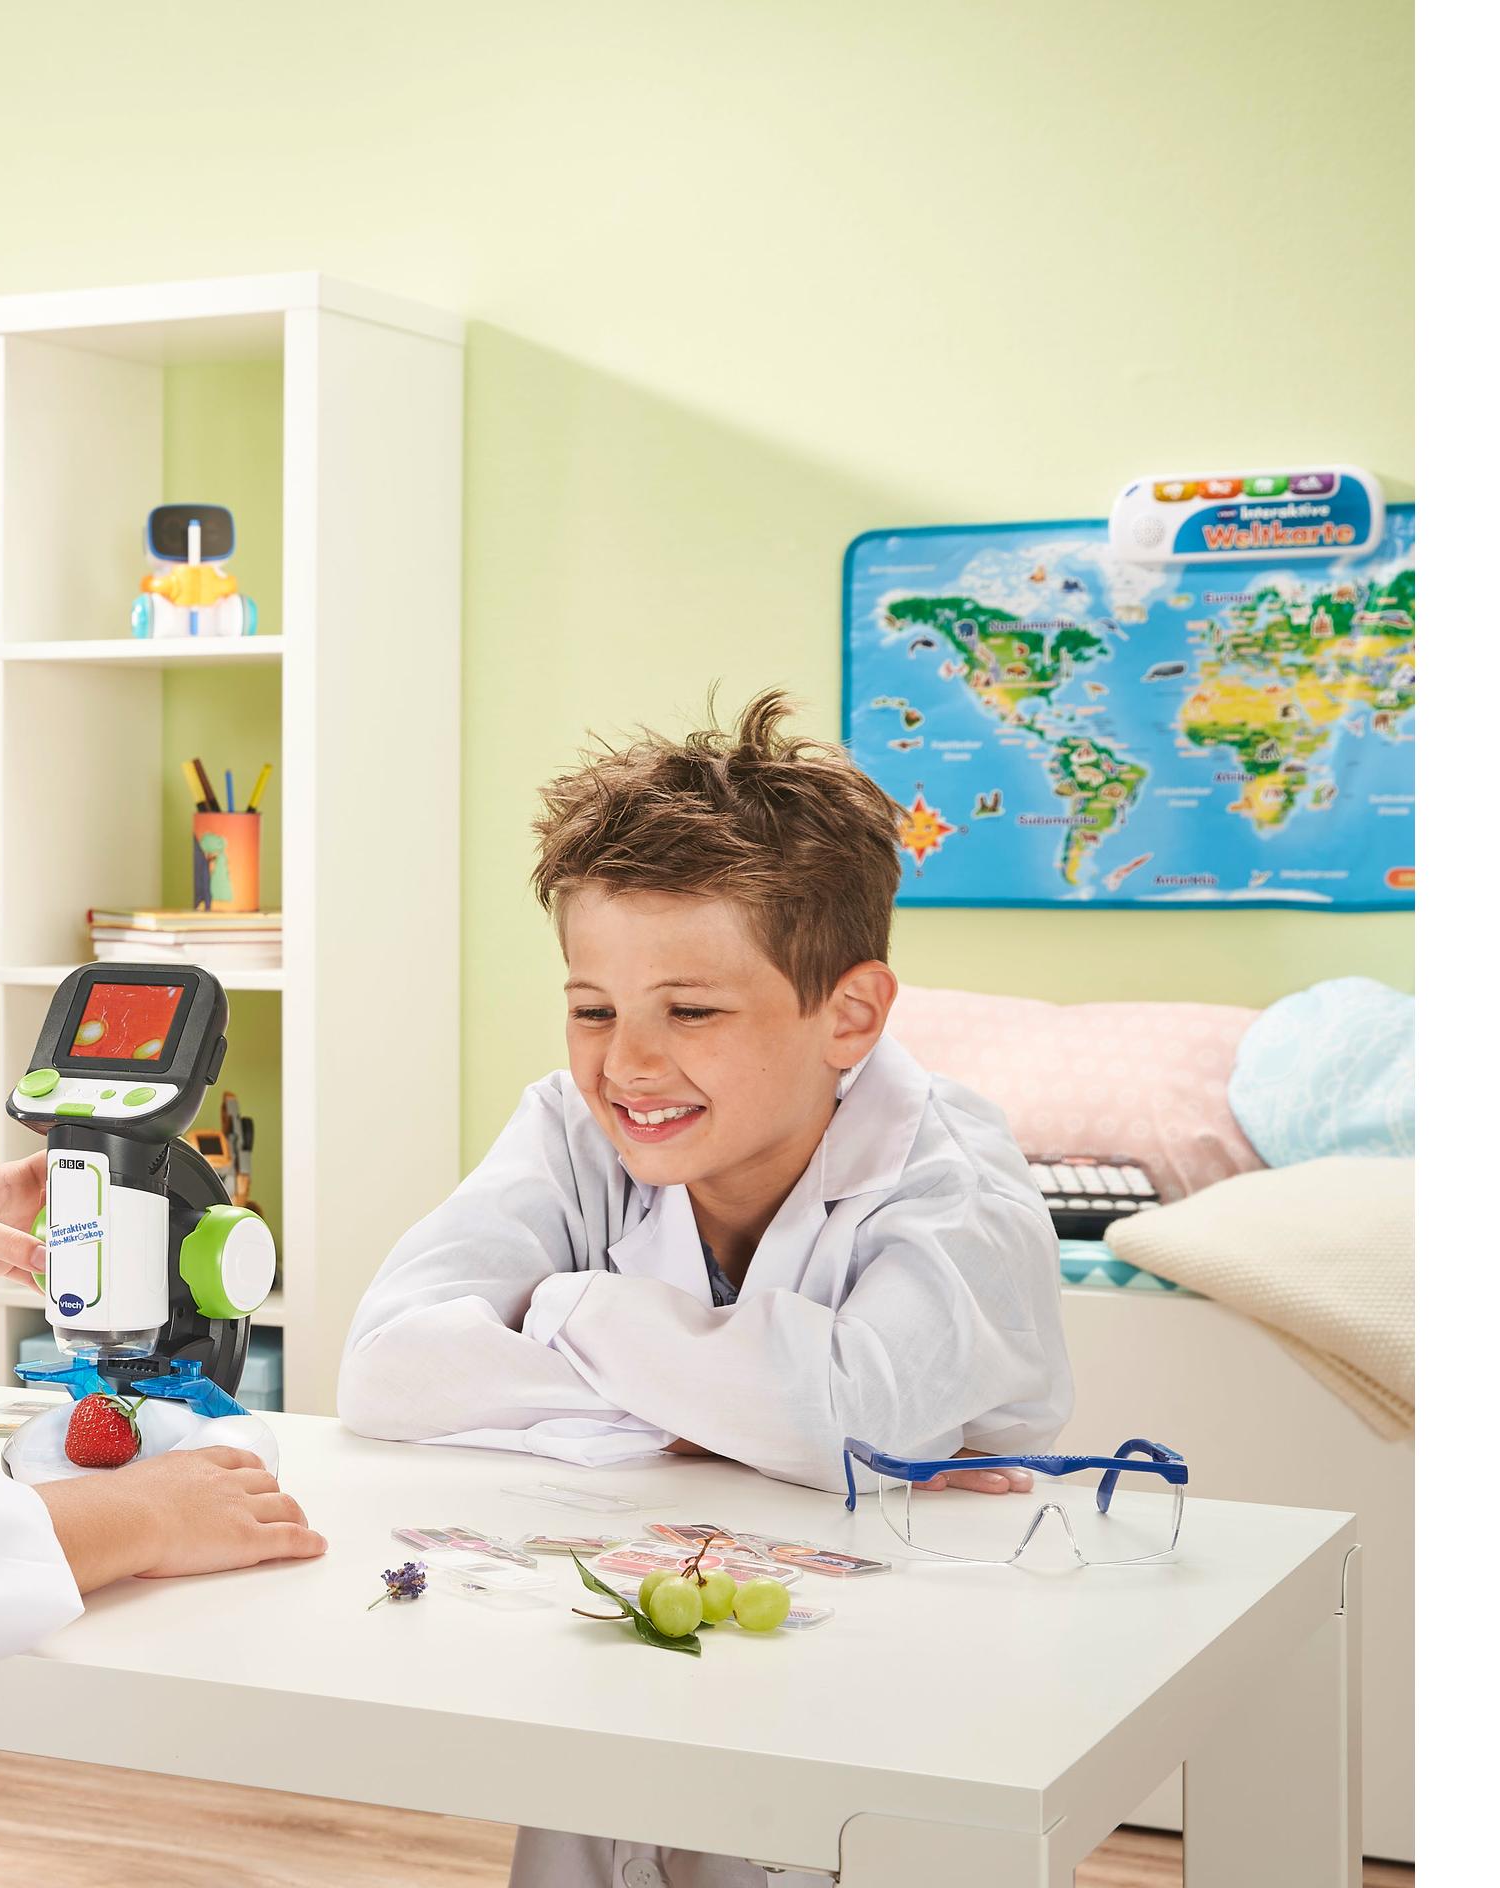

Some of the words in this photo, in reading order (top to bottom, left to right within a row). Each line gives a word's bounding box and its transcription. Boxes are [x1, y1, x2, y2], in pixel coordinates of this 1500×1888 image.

[1240, 503, 1330, 521] Interaktive
[1203, 521, 1355, 549] Weltkarte
[59, 1159, 85, 1170] BBC
[51, 1221, 98, 1237] Interaktives
[60, 1301, 82, 1309] vtech
